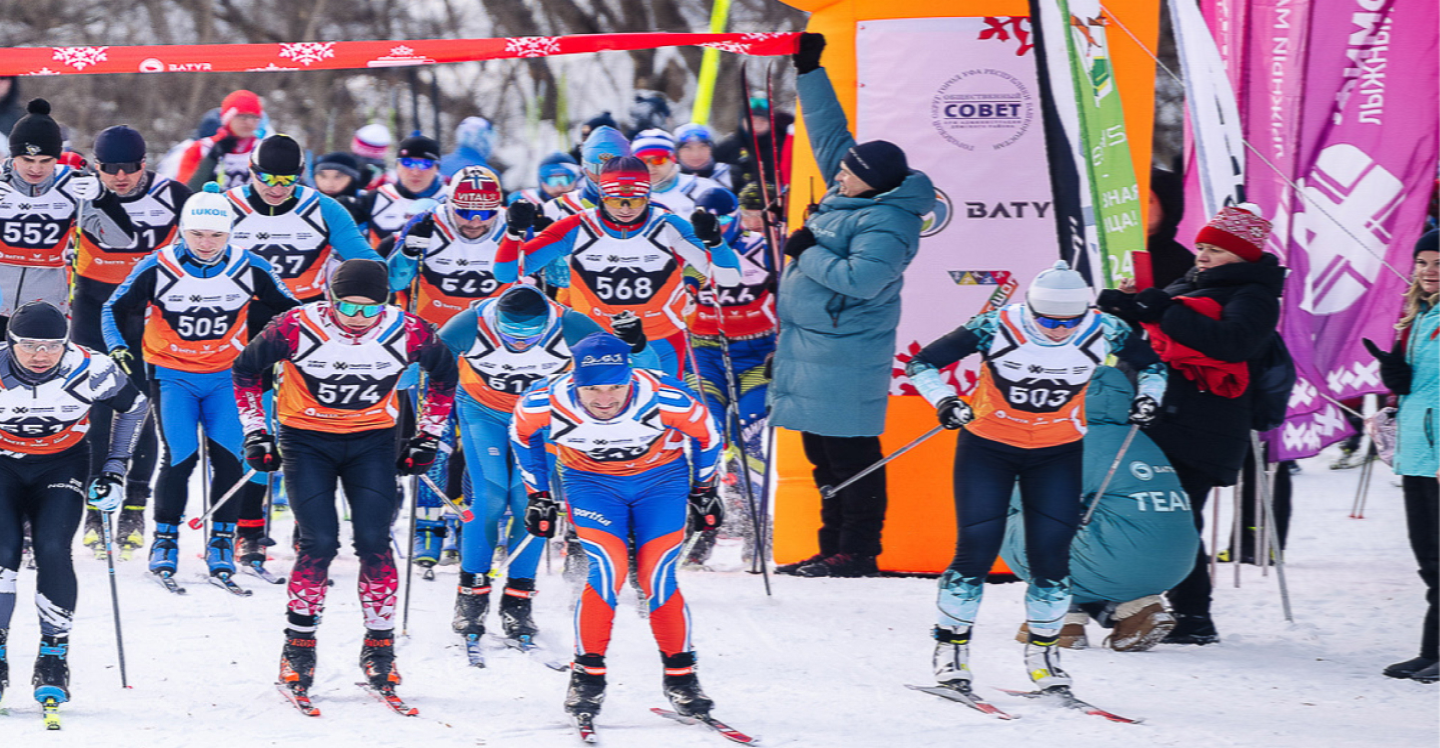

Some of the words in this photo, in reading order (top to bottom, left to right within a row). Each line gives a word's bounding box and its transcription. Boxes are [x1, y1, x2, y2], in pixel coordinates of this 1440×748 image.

[168, 62, 211, 71] BATYR
[1358, 8, 1394, 125] ЛЫЖНЫ
[944, 104, 1021, 117] СОВЕТ
[191, 208, 228, 217] LUKOIL
[965, 202, 1051, 218] BATY
[3, 221, 61, 244] 552
[271, 255, 305, 274] 67
[596, 276, 653, 300] 568
[178, 315, 228, 337] 505
[317, 383, 381, 404] 574
[488, 376, 538, 393] 51
[1010, 386, 1071, 407] 503
